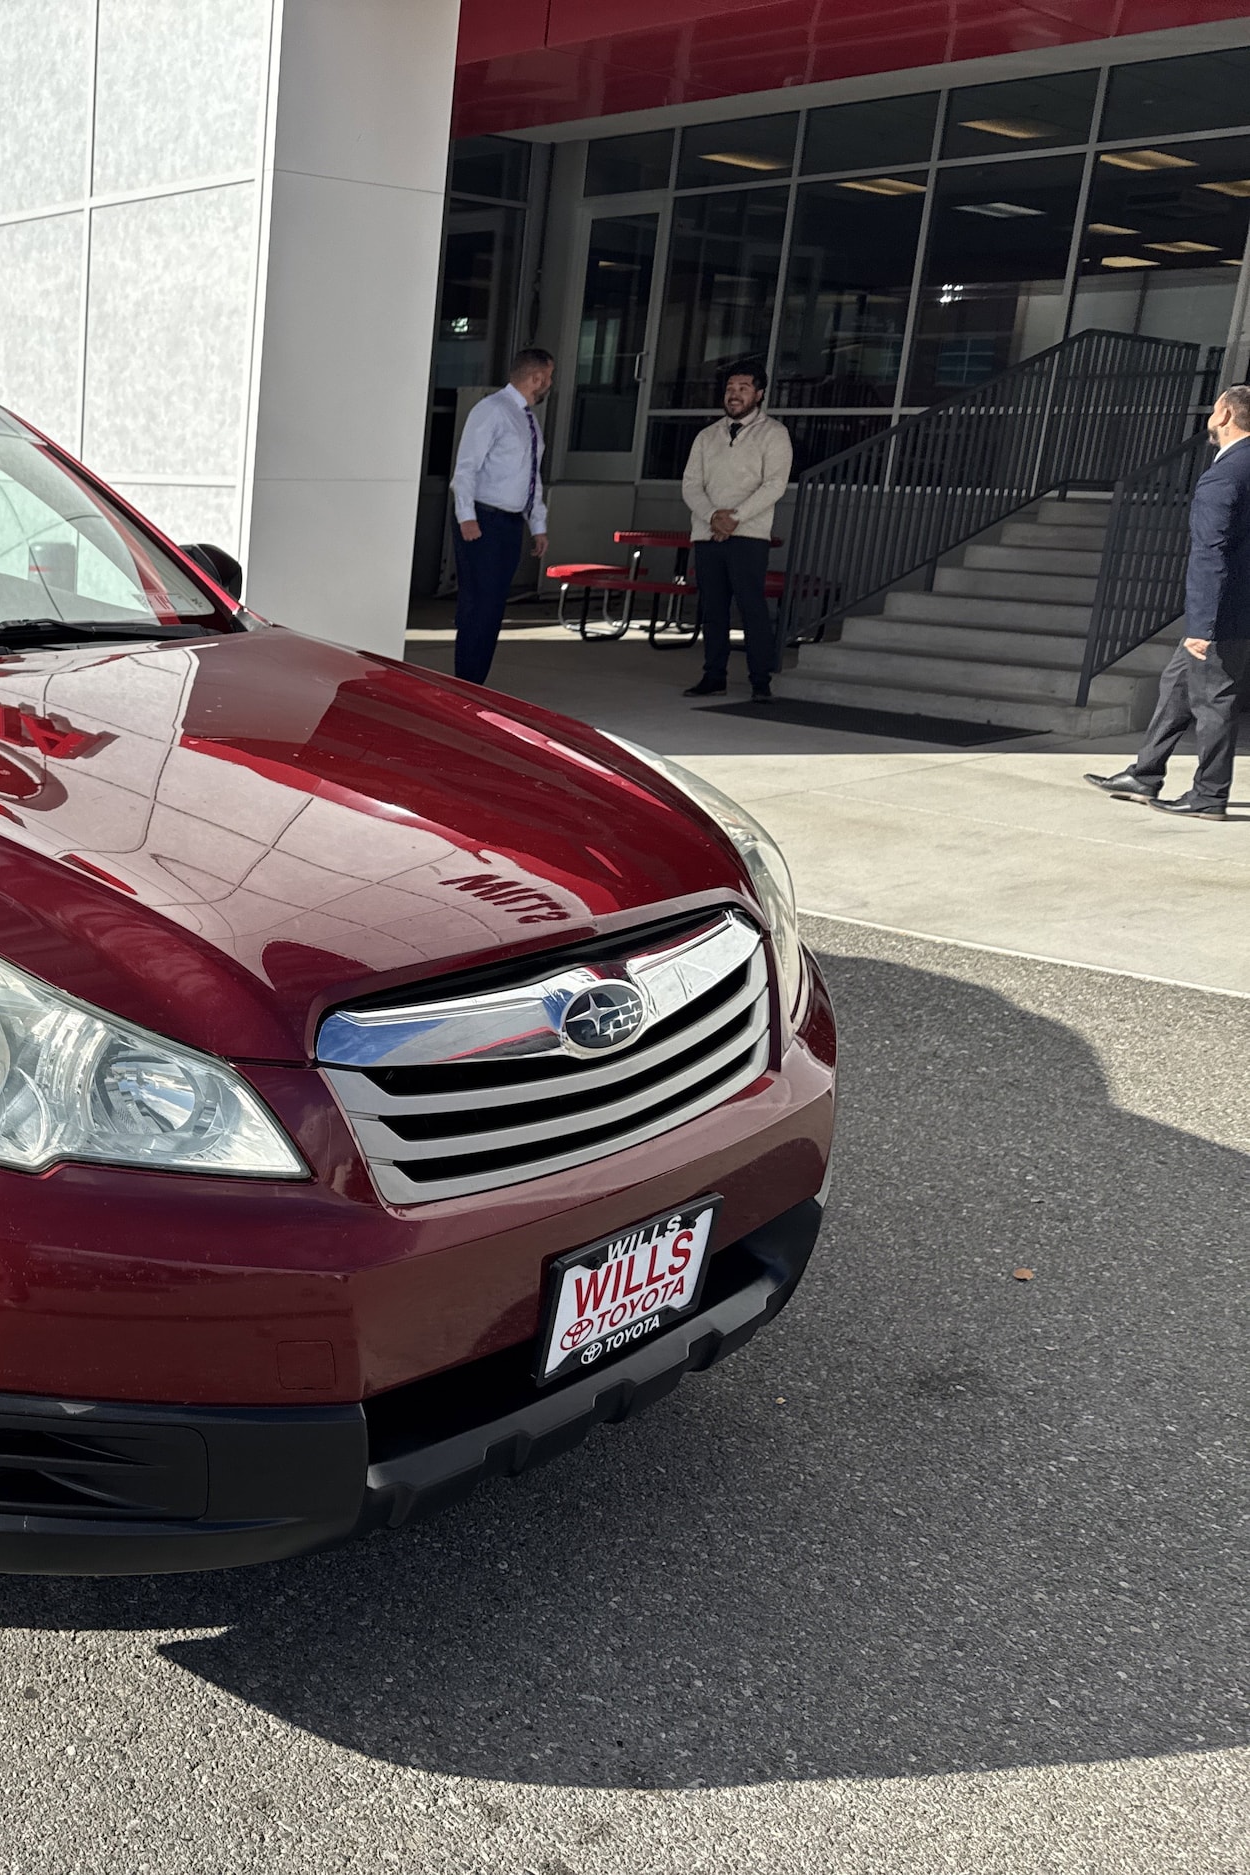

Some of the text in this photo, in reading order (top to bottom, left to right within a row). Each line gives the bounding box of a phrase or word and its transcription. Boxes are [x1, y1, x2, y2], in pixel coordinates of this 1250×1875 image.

[607, 1214, 682, 1262] WILLS
[574, 1230, 694, 1318] WILLS
[597, 1275, 685, 1333] TOYOTA
[605, 1314, 660, 1352] TOYOTA
